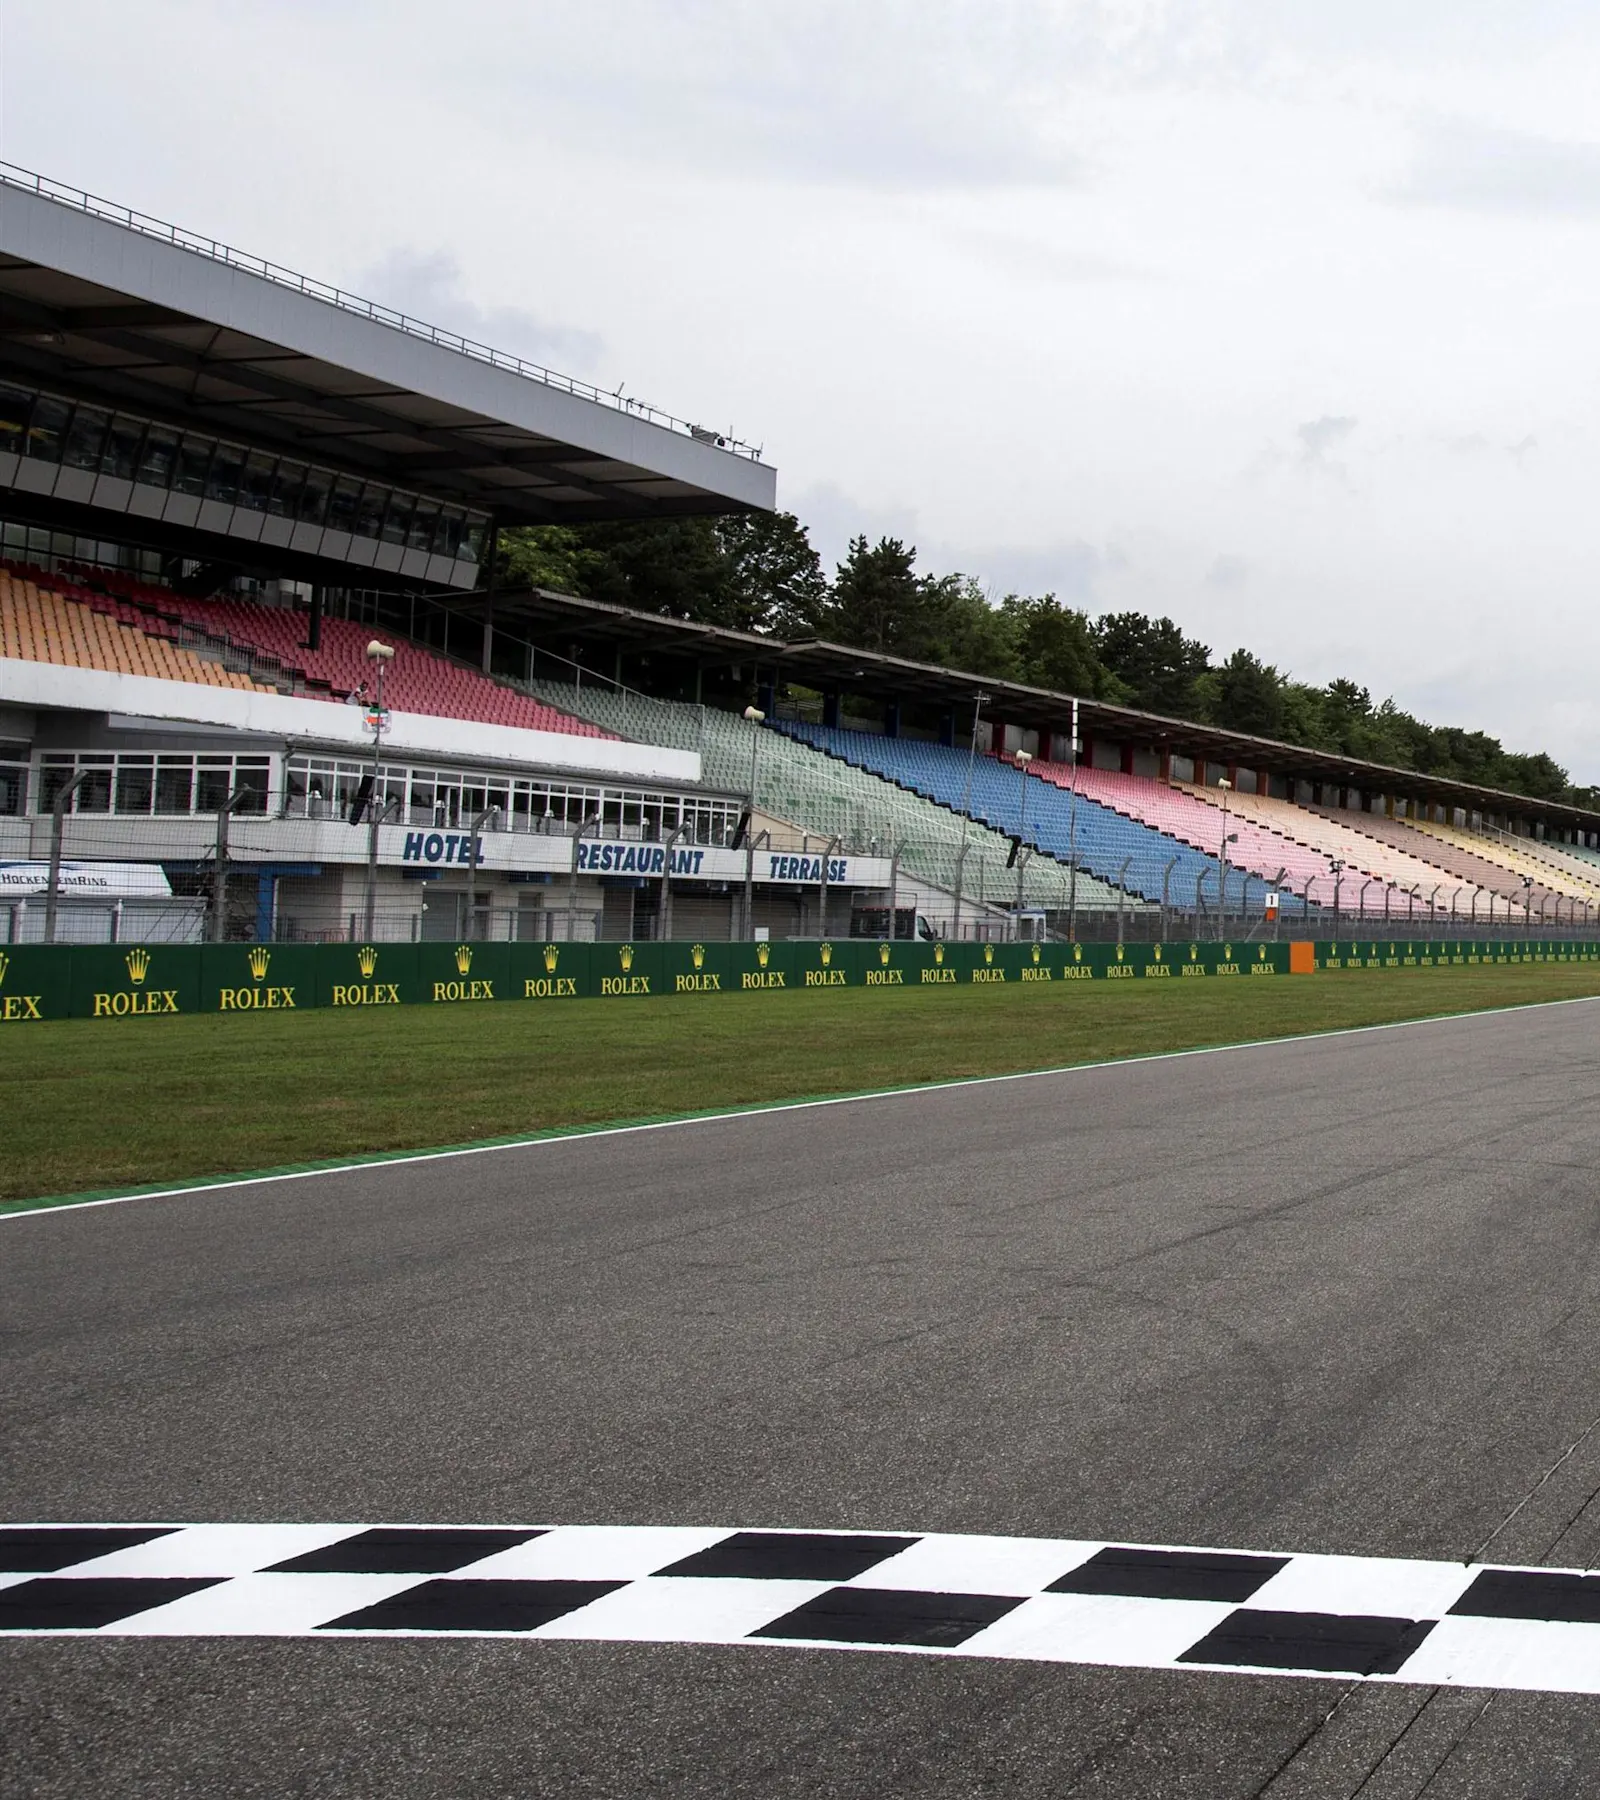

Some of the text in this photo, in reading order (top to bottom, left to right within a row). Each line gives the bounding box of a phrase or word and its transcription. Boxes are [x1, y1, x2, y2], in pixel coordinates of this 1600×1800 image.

[403, 833, 485, 863] HOTEL
[2, 874, 107, 886] HOCKENEIMRING
[921, 969, 956, 984] ROLEX
[972, 968, 1006, 983] ROLEX
[1022, 967, 1053, 982] ROLEX
[1063, 965, 1092, 979] ROLEX
[1107, 965, 1135, 979] ROLEX
[1146, 964, 1172, 977] ROLEX
[1181, 963, 1205, 977] ROLEX
[1217, 963, 1240, 976] ROLEX
[1251, 963, 1275, 975] ROLEX
[675, 975, 719, 992] ROLEX
[741, 973, 785, 988] ROLEX
[805, 971, 845, 986] ROLEX
[866, 970, 903, 985] ROLEX
[433, 981, 493, 1002] ROLEX
[524, 979, 577, 998] ROLEX
[602, 977, 649, 994] ROLEX
[220, 987, 296, 1011] ROLEX
[333, 984, 400, 1006] ROLEX
[94, 991, 178, 1017] ROLEX
